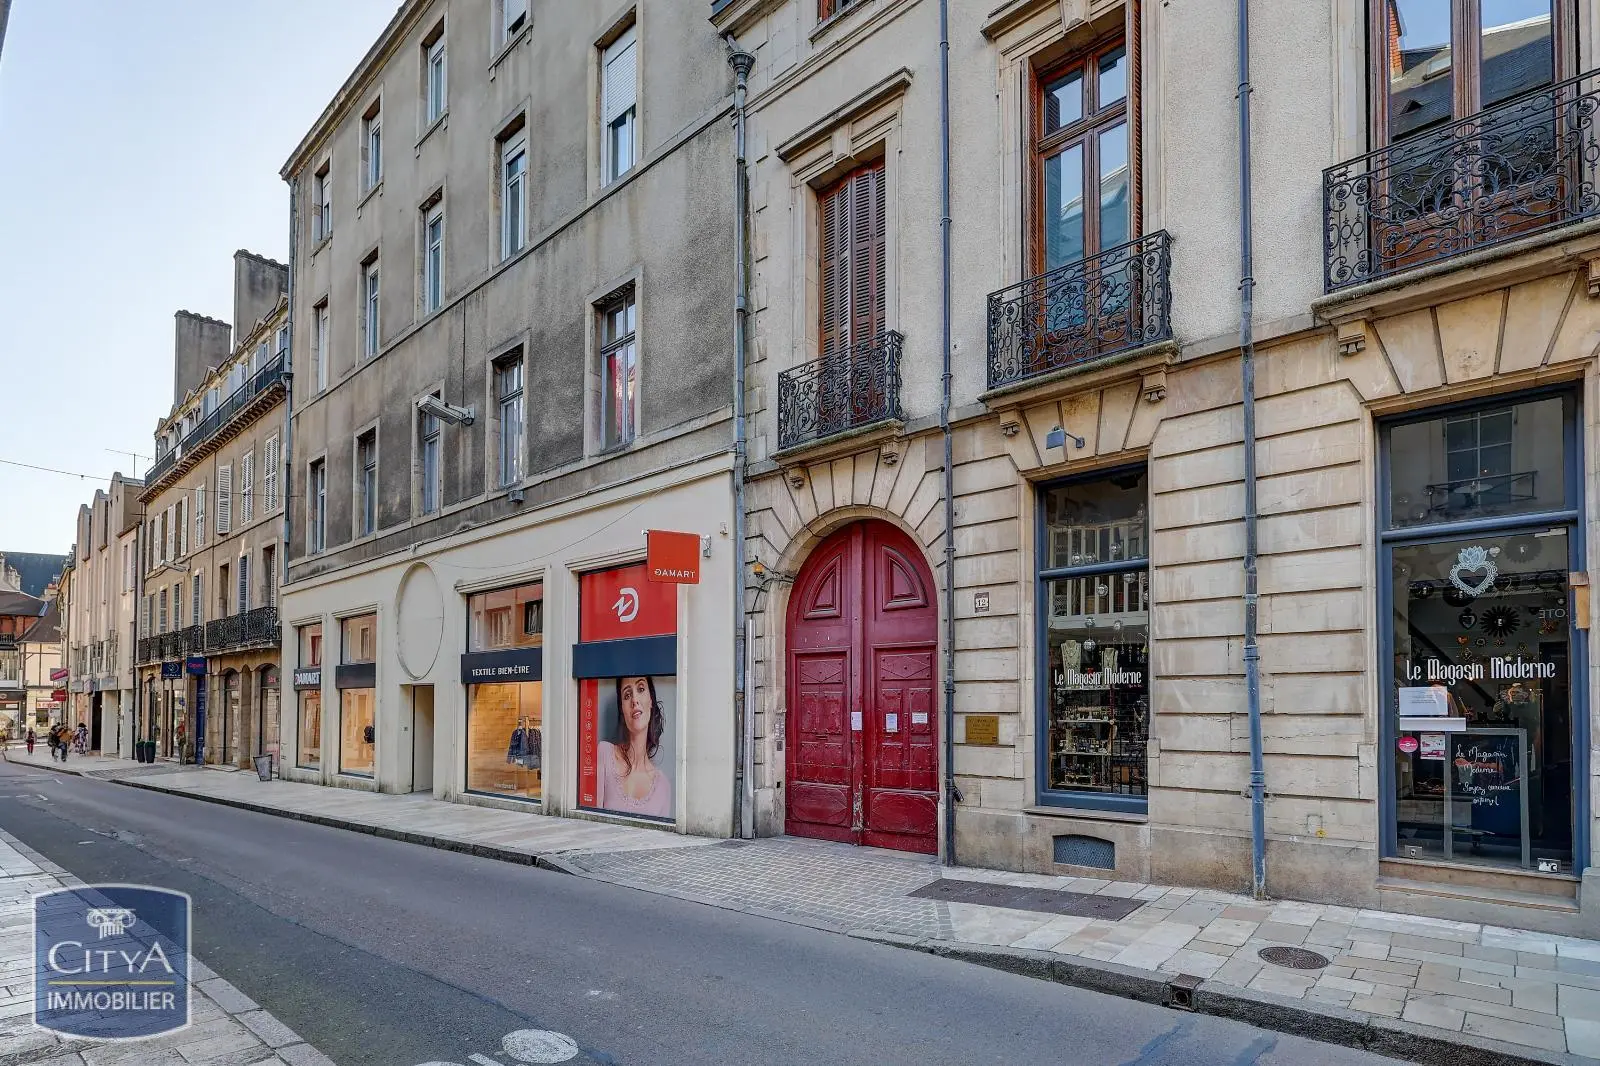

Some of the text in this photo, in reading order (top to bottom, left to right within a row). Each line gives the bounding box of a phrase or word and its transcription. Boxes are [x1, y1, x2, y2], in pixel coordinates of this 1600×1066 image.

[977, 598, 987, 607] 12
[472, 664, 531, 677] TEXTILE BIEN-ÊTRE
[1054, 667, 1142, 690] Le Magasin Moderne
[1406, 656, 1556, 686] Le Magasin Moderne
[1455, 743, 1465, 758] Le
[1468, 744, 1508, 763] Magasin
